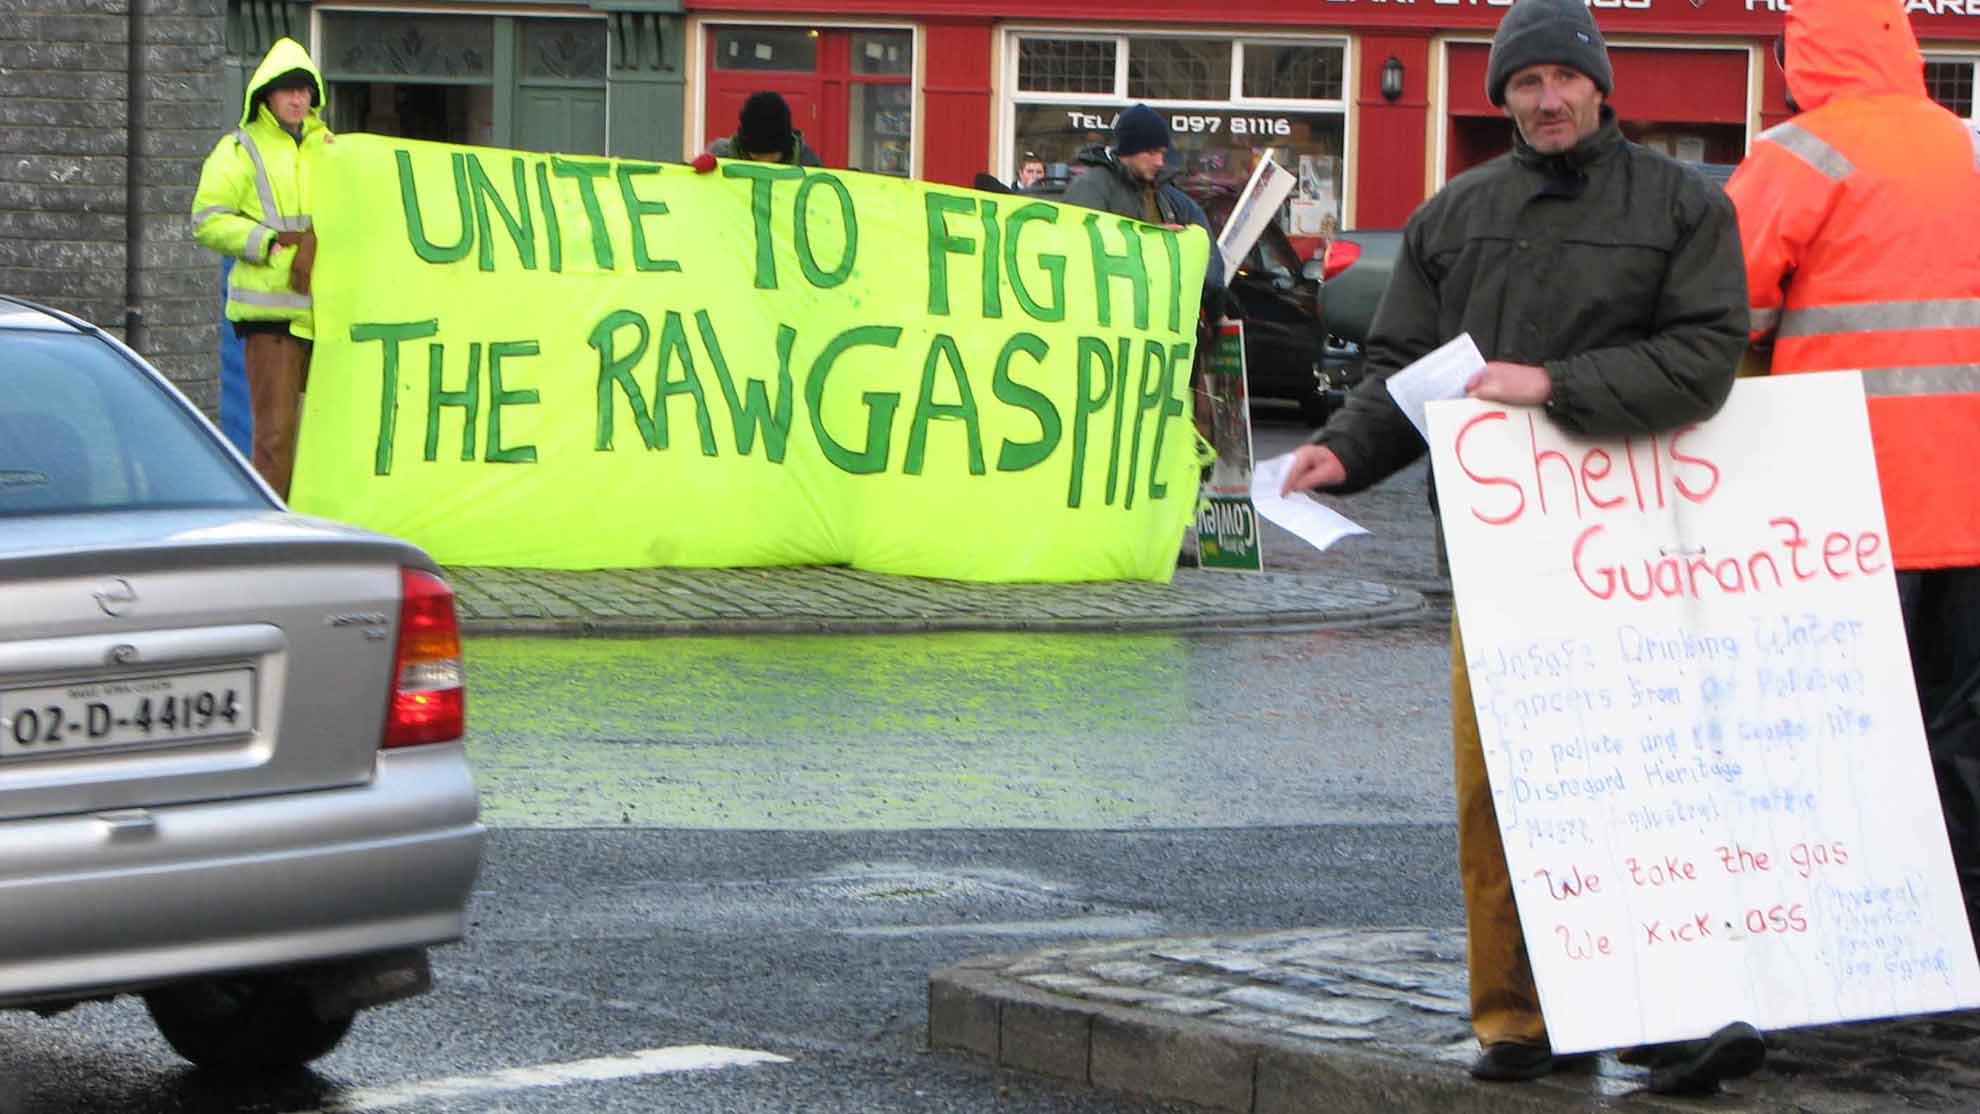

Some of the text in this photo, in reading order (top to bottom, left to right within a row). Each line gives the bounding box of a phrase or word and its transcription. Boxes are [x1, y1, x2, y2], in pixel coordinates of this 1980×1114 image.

[1171, 115, 1222, 133] 097
[1230, 117, 1291, 135] 81116
[394, 149, 682, 273] UNITE
[721, 164, 859, 290] TO
[924, 191, 1184, 334] FIGHT
[350, 318, 541, 477] THE
[1066, 335, 1191, 510] PIPE
[1455, 411, 1721, 526] Shells
[1572, 516, 1887, 601] Guarantee
[12, 688, 240, 746] 02-D-44194
[1638, 728, 1677, 755] and
[1512, 756, 1744, 804] Disregard Heritage
[1535, 842, 1850, 902] We take the gas
[1554, 924, 1613, 961] We
[1745, 903, 1809, 935] ass
